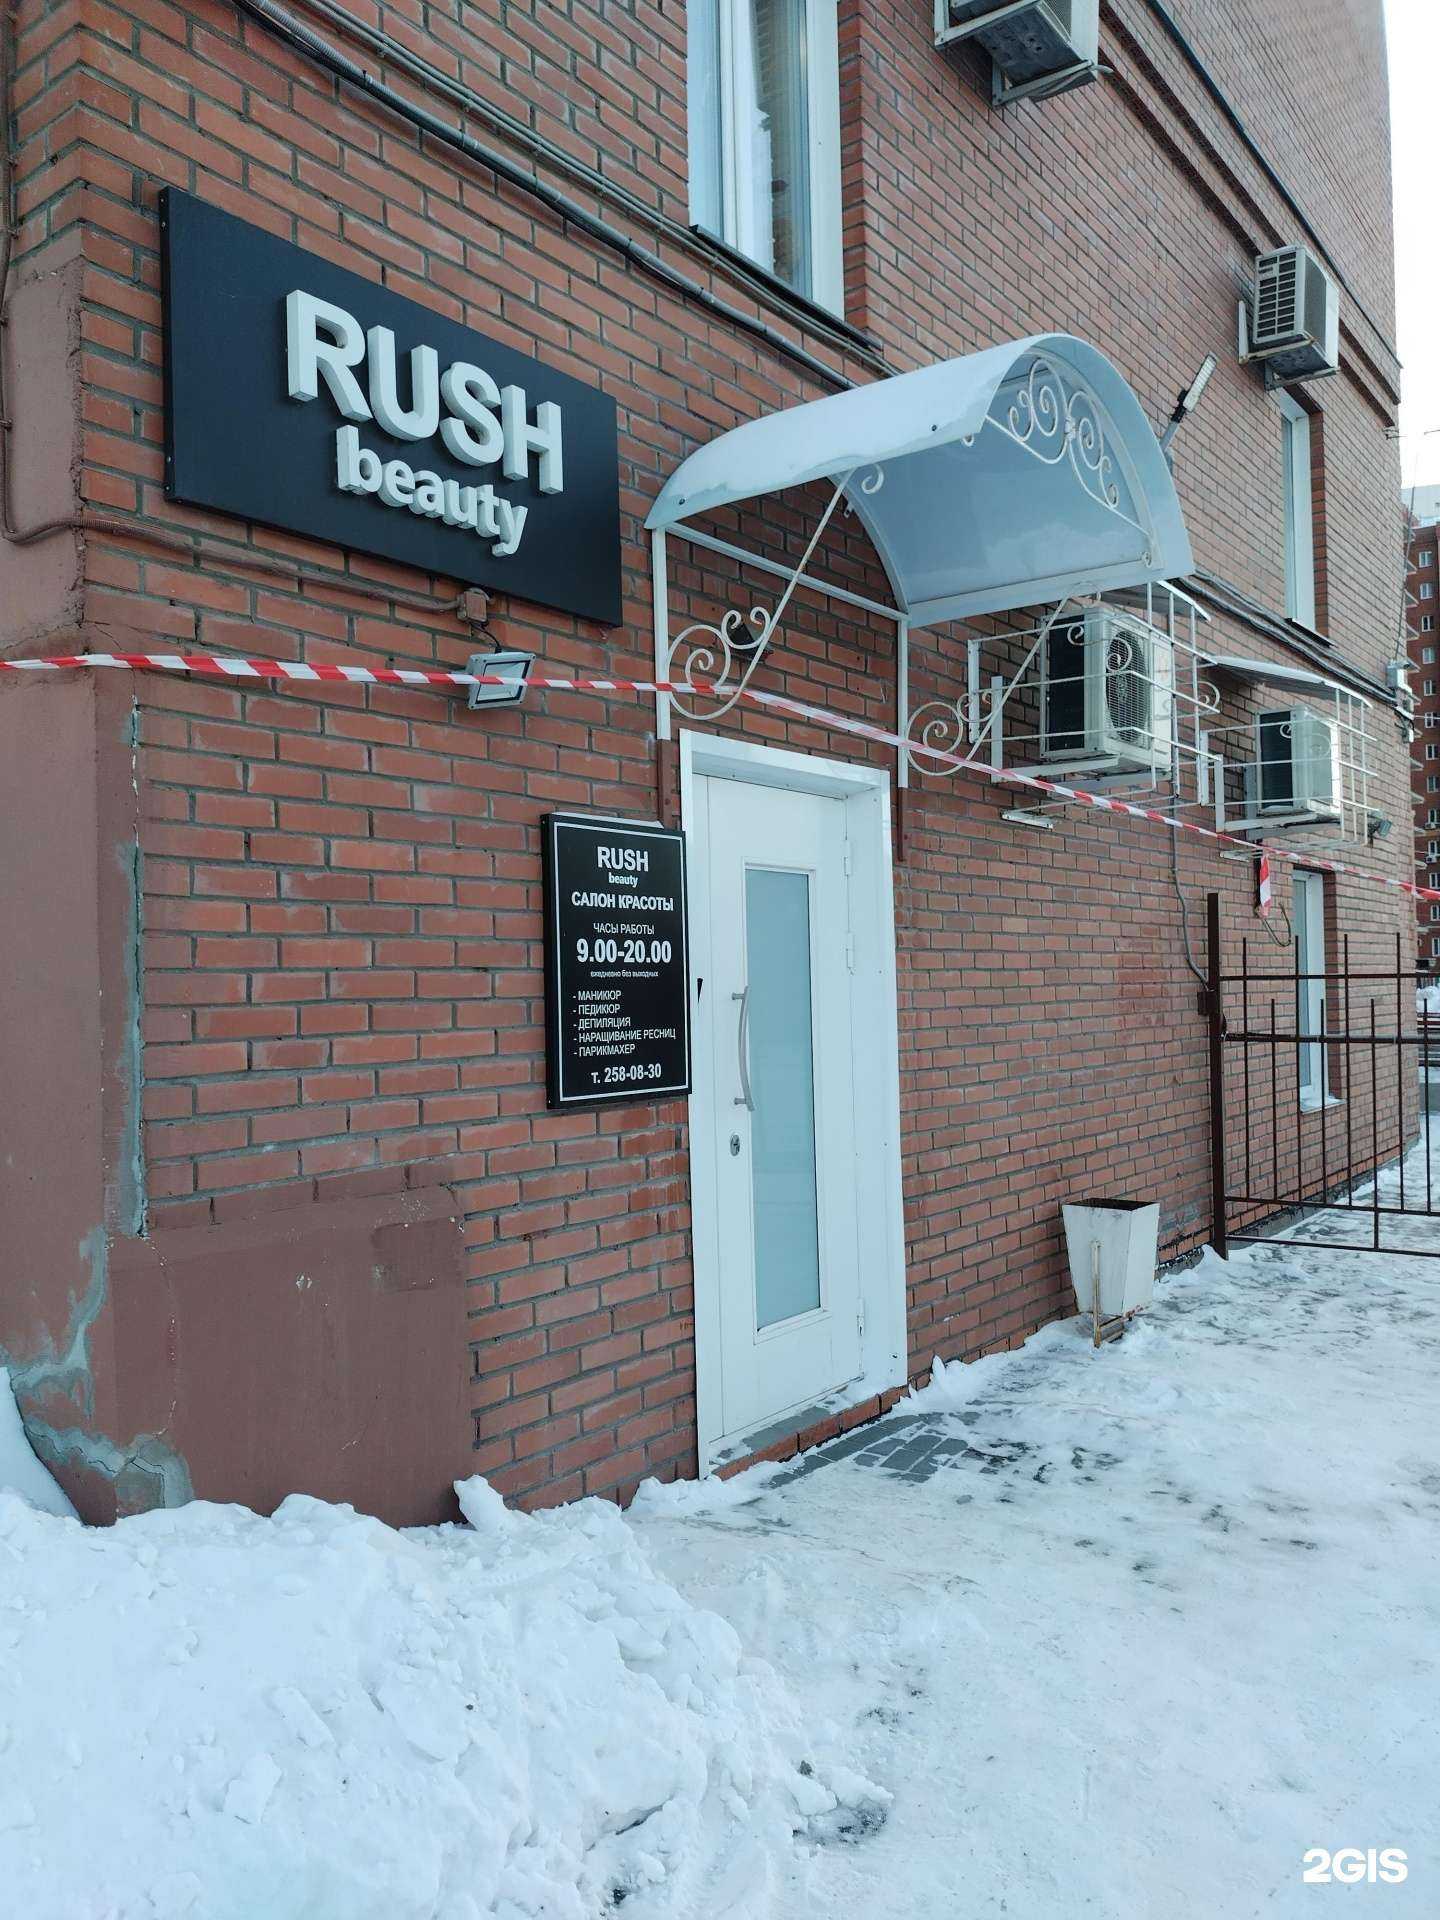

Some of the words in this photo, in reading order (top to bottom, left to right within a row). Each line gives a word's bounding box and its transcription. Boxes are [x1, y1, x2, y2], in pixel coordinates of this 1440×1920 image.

[286, 289, 564, 495] RUSH
[336, 424, 529, 557] beauty
[597, 846, 649, 872] RUSH
[608, 872, 639, 888] beauty
[571, 891, 616, 909] САЛОН
[618, 894, 674, 911] КРАСОТЫ
[593, 922, 619, 934] ЧАСЫ
[620, 923, 655, 935] РАБОТЫ
[576, 938, 672, 964] 9.00-20.00
[578, 990, 622, 1001] МАНИКЮР
[578, 1003, 621, 1016] ПЕДИКЮР
[578, 1017, 631, 1030] ДЕПИЛЯЦИЯ
[579, 1029, 642, 1043] НАРАЩИВАНИЕ
[643, 1028, 676, 1040] РЕСНИЦ
[579, 1043, 636, 1057] ПАРИКМАХЕР
[604, 1063, 662, 1083] 258-08-30
